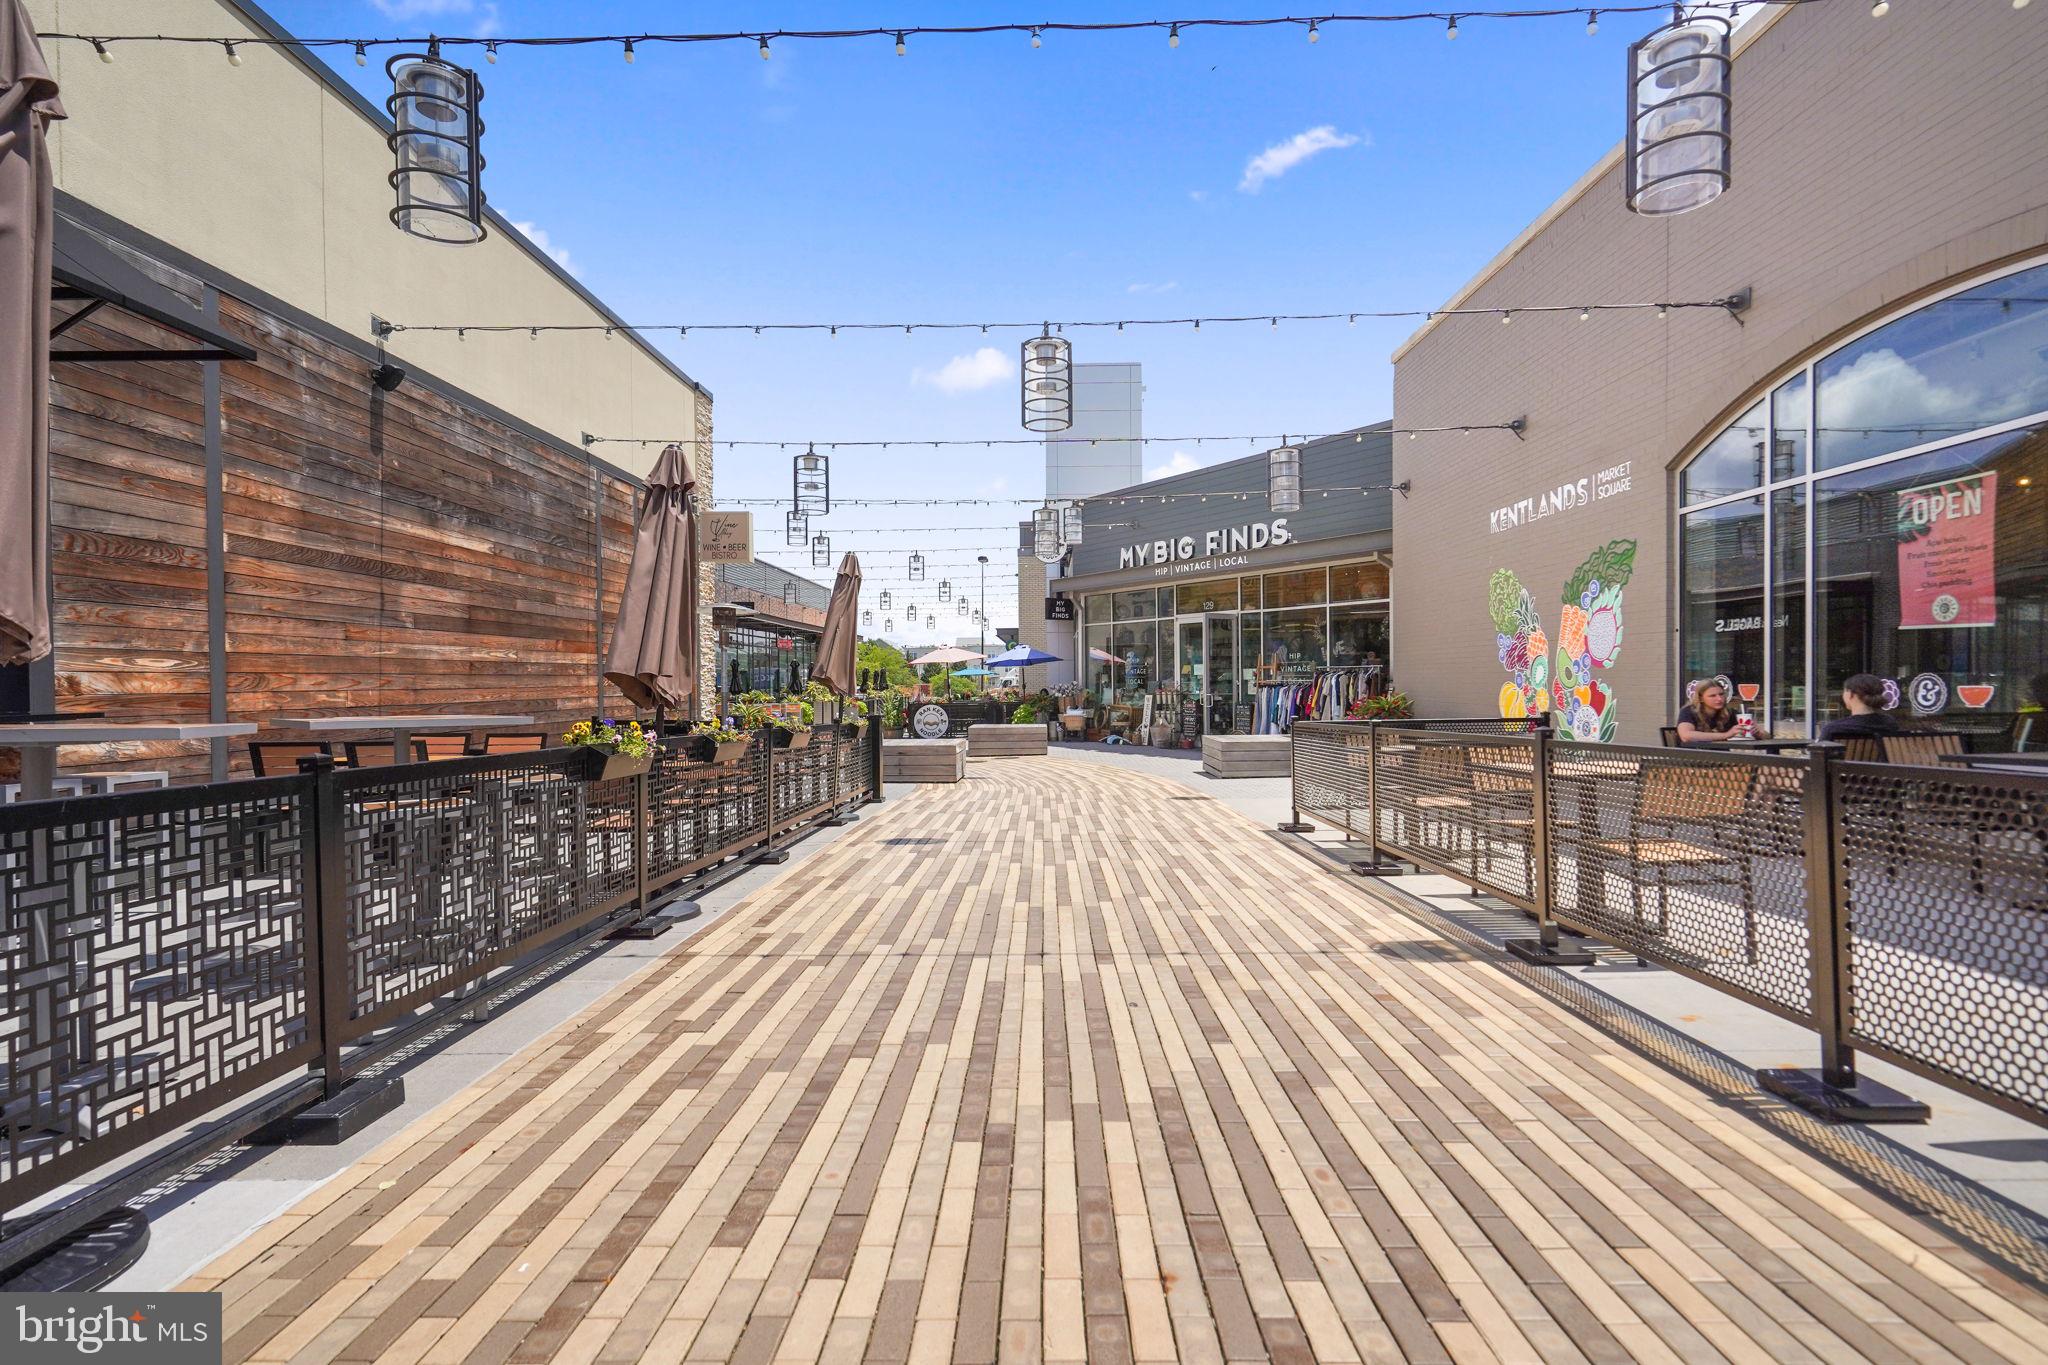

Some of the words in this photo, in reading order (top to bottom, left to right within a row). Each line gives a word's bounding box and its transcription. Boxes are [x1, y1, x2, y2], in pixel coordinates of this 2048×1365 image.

[1598, 461, 1632, 484] MARKET
[1598, 477, 1632, 499] SQUARE
[1490, 478, 1588, 534] KENTLANDS
[1912, 487, 1982, 525] OPEN
[702, 543, 721, 551] WINE
[728, 543, 747, 551] BEER
[711, 551, 738, 560] BISTRO
[1155, 567, 1168, 576] HIP
[1174, 560, 1212, 574] VINTAGE
[1219, 556, 1249, 567] LOCAL
[1203, 601, 1214, 610] 129
[918, 707, 931, 717] RAN
[920, 728, 943, 737] NOODLE
